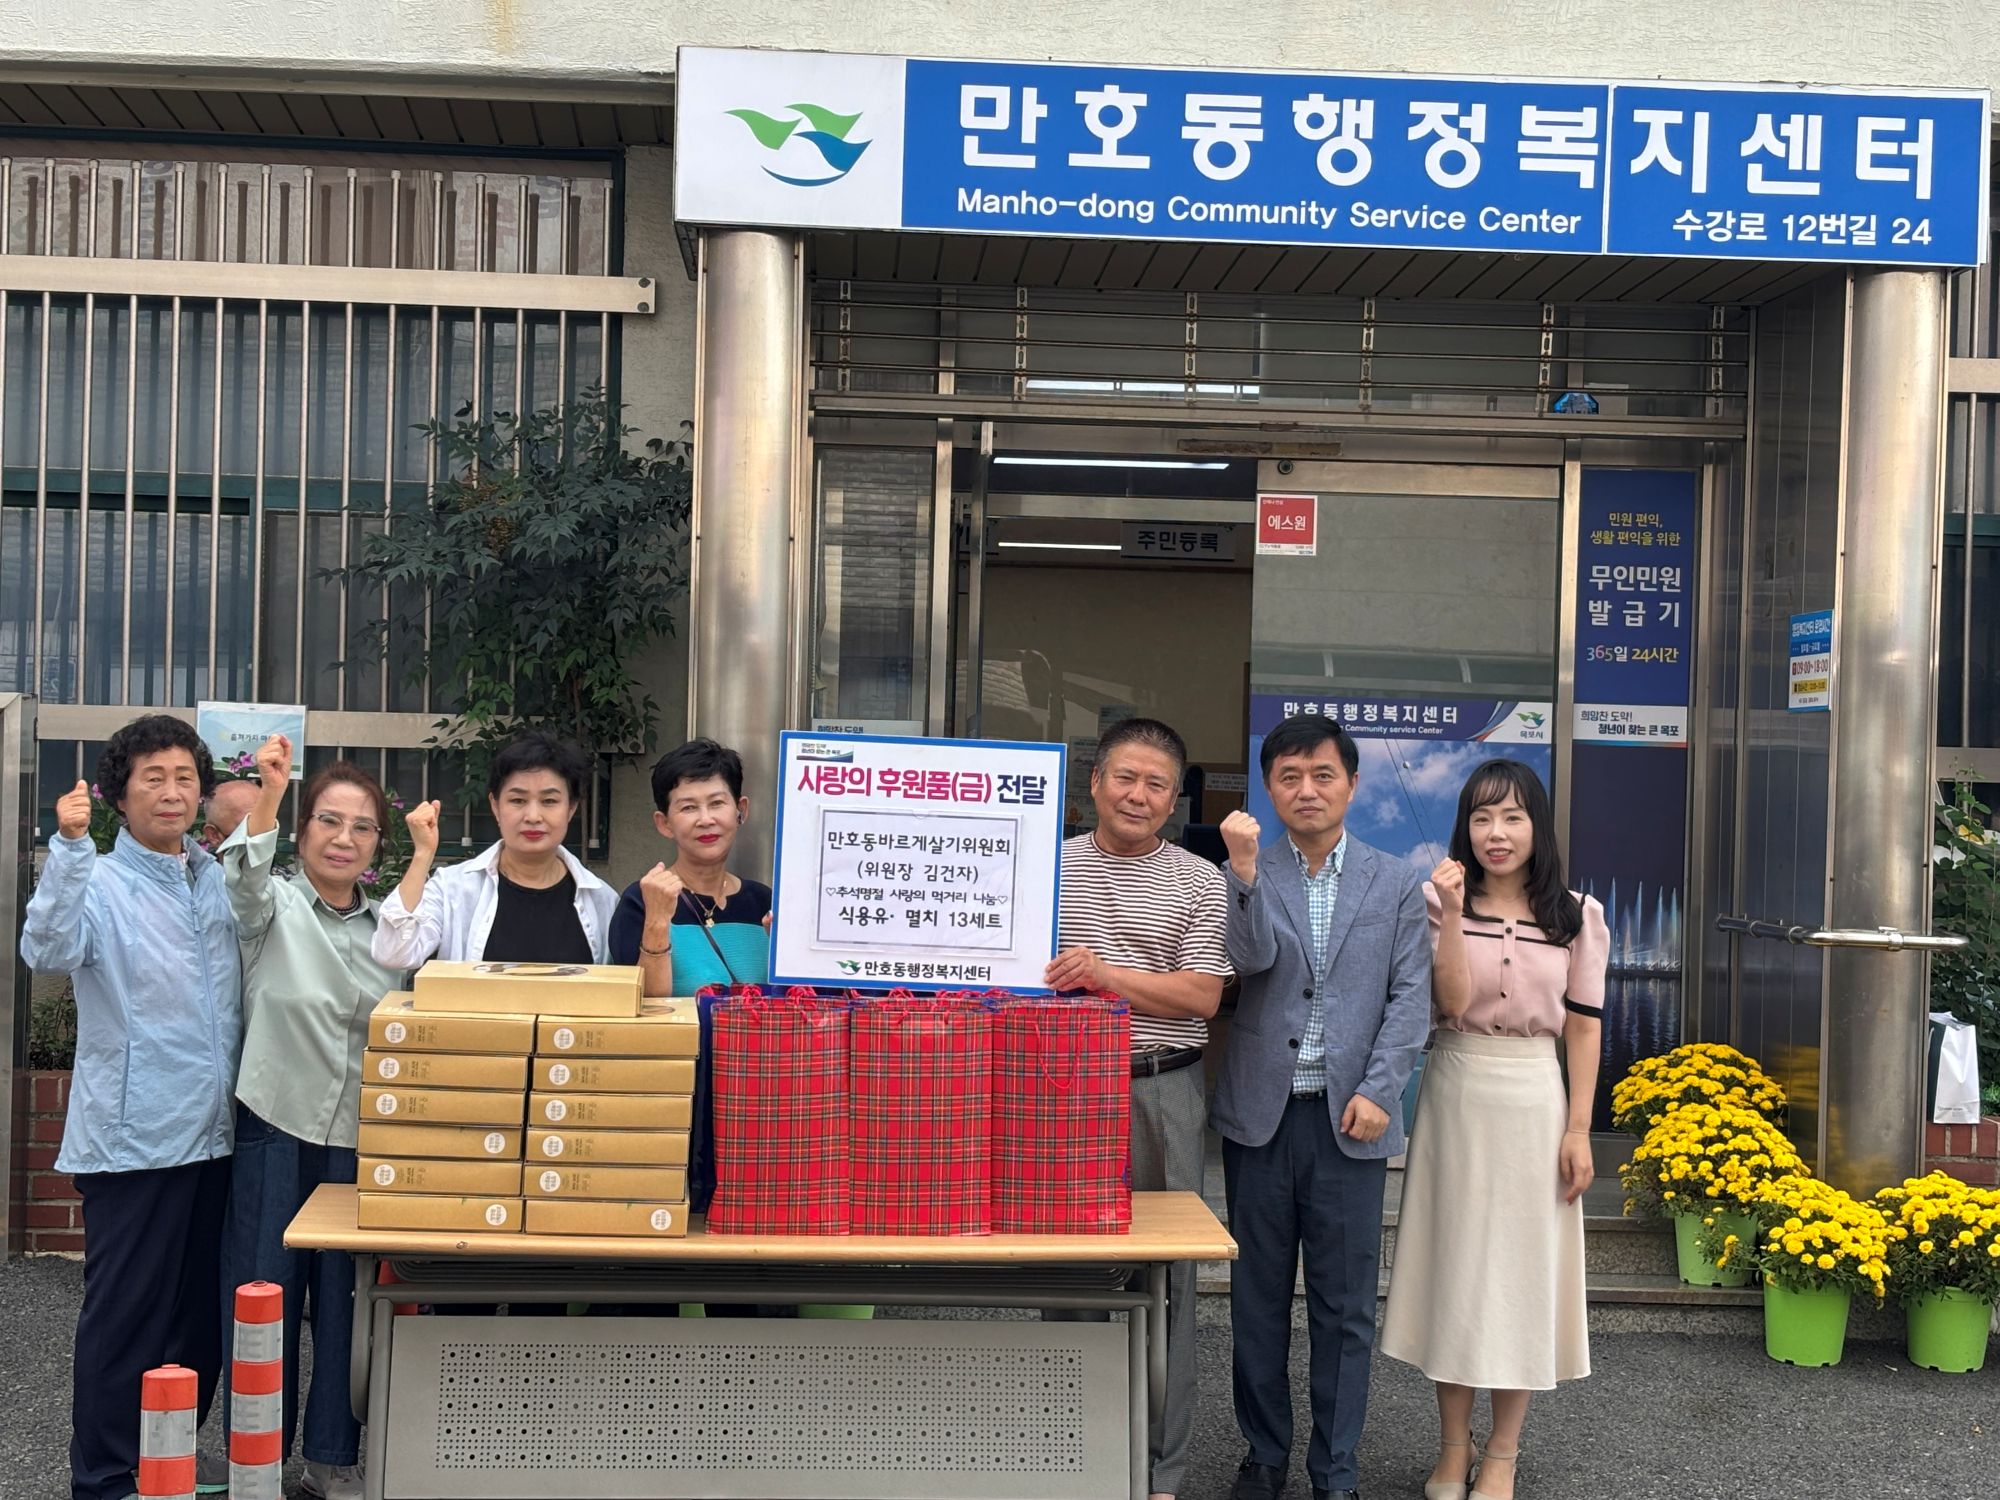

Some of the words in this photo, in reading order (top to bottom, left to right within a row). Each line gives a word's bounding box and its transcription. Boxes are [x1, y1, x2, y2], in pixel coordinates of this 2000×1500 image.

[959, 83, 1936, 200] 만호동행정복지센터
[957, 187, 1155, 223] Manho-dong
[1167, 196, 1335, 231] Community
[1348, 201, 1467, 232] Service
[1478, 206, 1582, 235] Center
[1672, 208, 1768, 242] 수강로
[1782, 212, 1878, 246] 12번길
[1891, 218, 1933, 246] 24
[1267, 514, 1307, 531] 에스원
[1608, 513, 1633, 527] 민원
[1137, 530, 1219, 552] 주민등록
[1590, 531, 1614, 545] 생활
[1617, 531, 1653, 546] 편익을
[1656, 532, 1680, 546] 위한
[1588, 565, 1681, 593] 무인민원
[1586, 645, 1628, 662] 365일
[1631, 646, 1679, 663] 24시간
[1283, 701, 1458, 724] 만호동행정복지센터
[1580, 710, 1608, 722] 희망찬
[1610, 711, 1633, 722] 도약!
[1344, 724, 1387, 735] Community
[1389, 725, 1416, 735] service
[1418, 726, 1443, 735] Center
[1628, 724, 1646, 735] 찾는
[1648, 725, 1658, 736] 큰
[1660, 725, 1680, 736] 목포
[797, 765, 872, 797] 사랑의
[876, 767, 992, 804] 후원품(금)
[996, 774, 1048, 805] 전달
[827, 831, 1011, 856] 만호동바르게살기위원회
[857, 860, 914, 882] (위원장
[924, 864, 979, 885] 김건자)
[836, 886, 884, 901] 추석명절
[889, 888, 925, 903] 사랑의
[931, 890, 967, 904] 먹거리
[973, 892, 998, 906] 나눔
[905, 909, 938, 929] 멸치
[949, 911, 1003, 930] 13세트
[864, 960, 991, 981] 만호동행정복지센터
